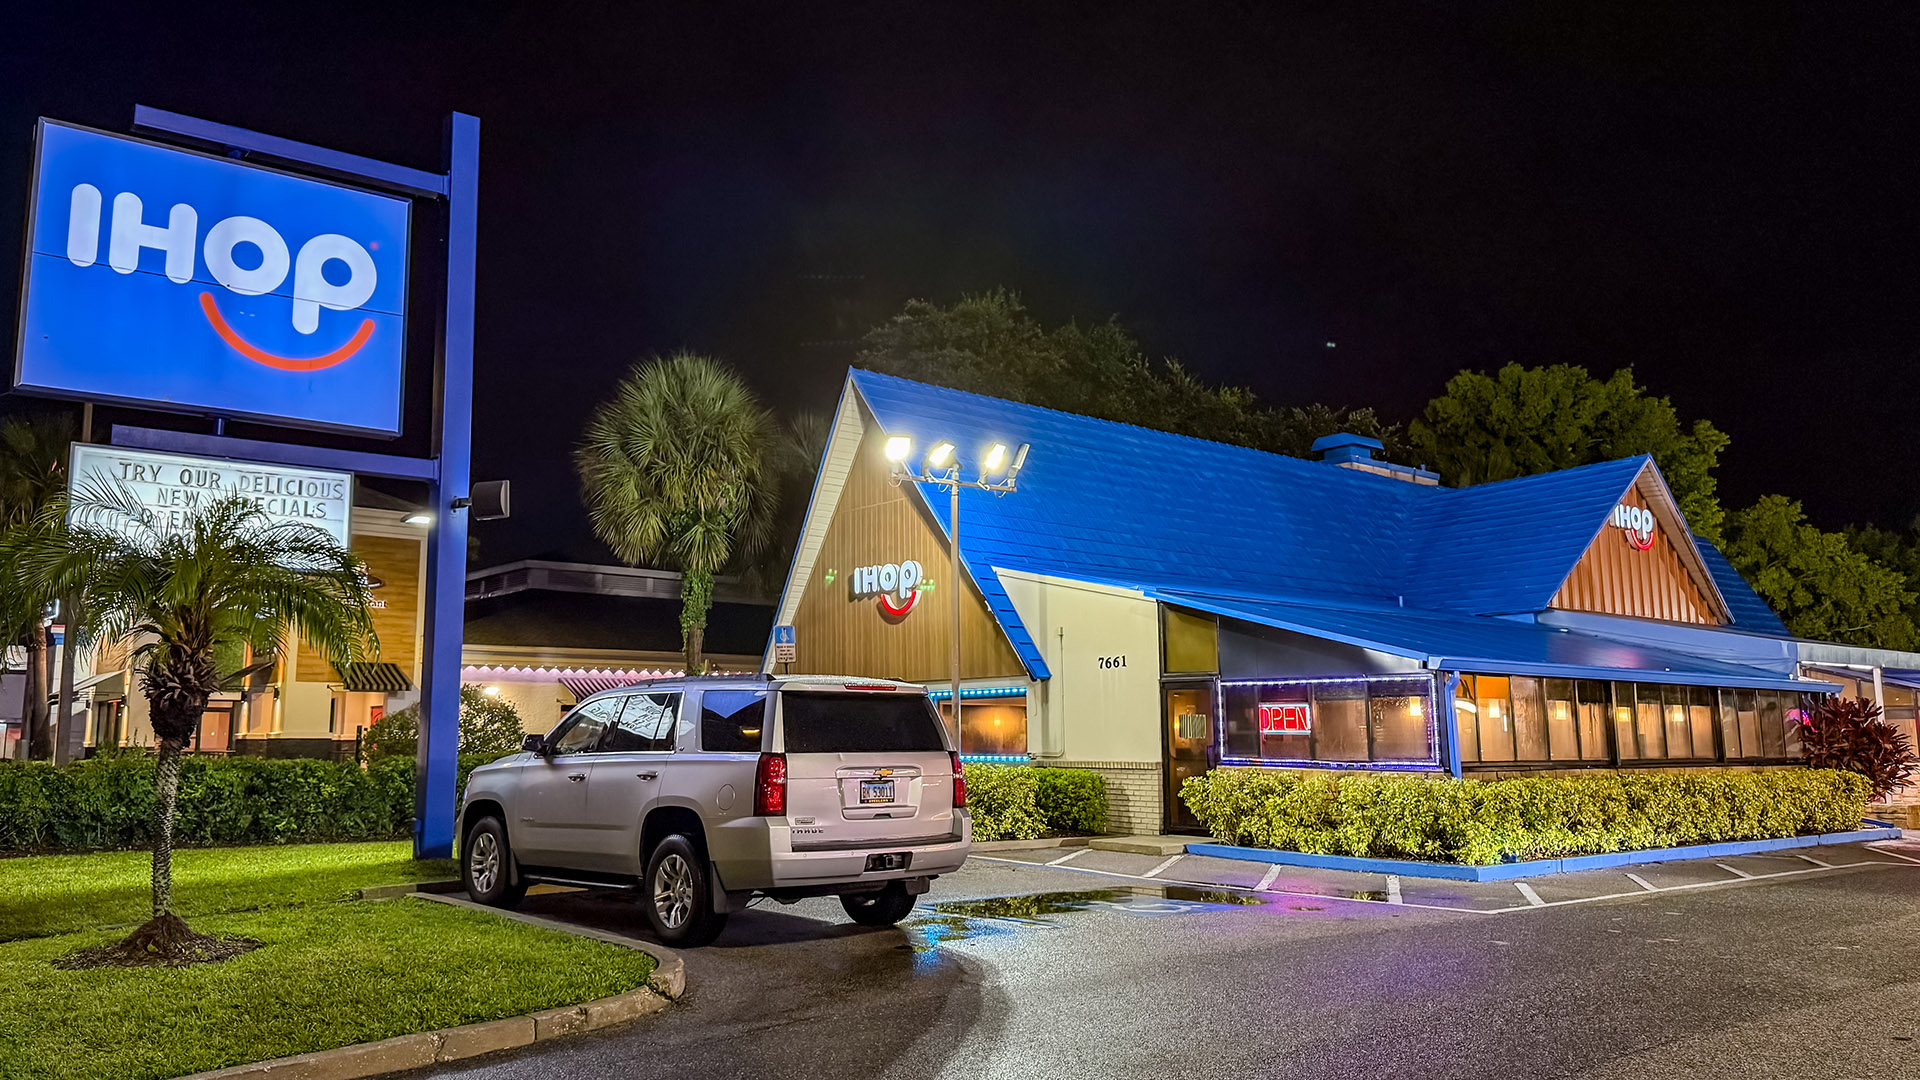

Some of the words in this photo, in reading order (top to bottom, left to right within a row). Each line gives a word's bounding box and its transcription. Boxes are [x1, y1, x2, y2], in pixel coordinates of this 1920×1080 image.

[66, 182, 378, 335] IHOP
[119, 461, 162, 482] TRY
[179, 468, 221, 489] OUR
[239, 474, 344, 501] DELICIOUS
[157, 487, 200, 507] NEW
[1612, 503, 1654, 540] IHOP
[853, 559, 921, 600] IHOP
[1097, 654, 1128, 670] 7661
[1258, 706, 1309, 731] OPEN
